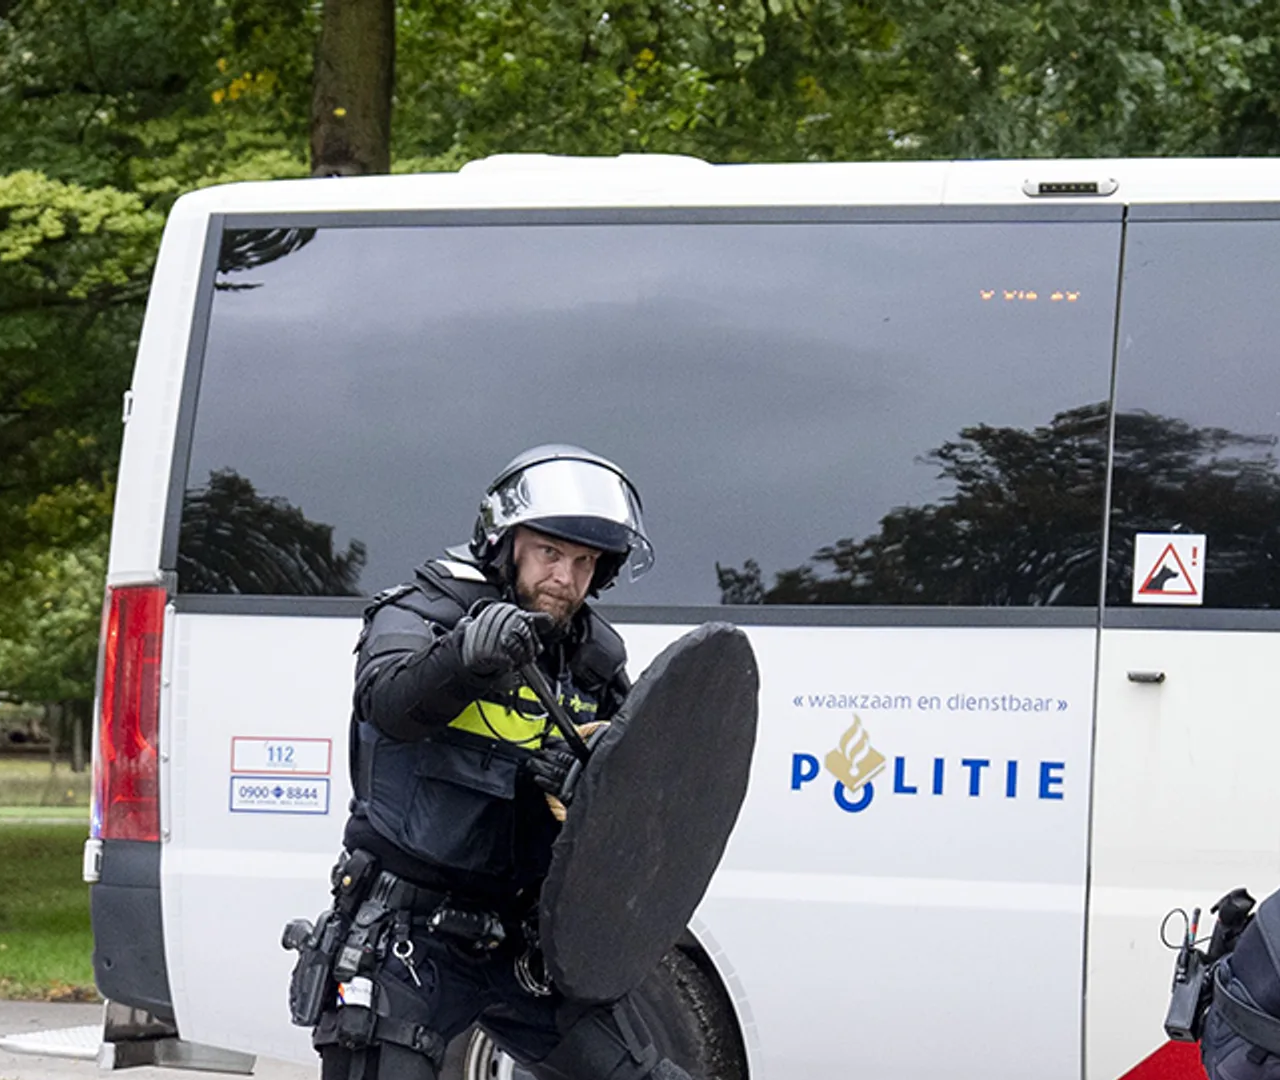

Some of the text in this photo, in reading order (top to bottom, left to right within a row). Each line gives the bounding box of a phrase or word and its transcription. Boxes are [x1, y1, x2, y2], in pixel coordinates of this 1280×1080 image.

[808, 693, 912, 710] waakzaam
[918, 696, 942, 711] en
[947, 693, 1052, 712] dienstbaar
[268, 746, 294, 762] 112
[790, 752, 1066, 814] POLITIE
[239, 786, 317, 799] 0900 8844
